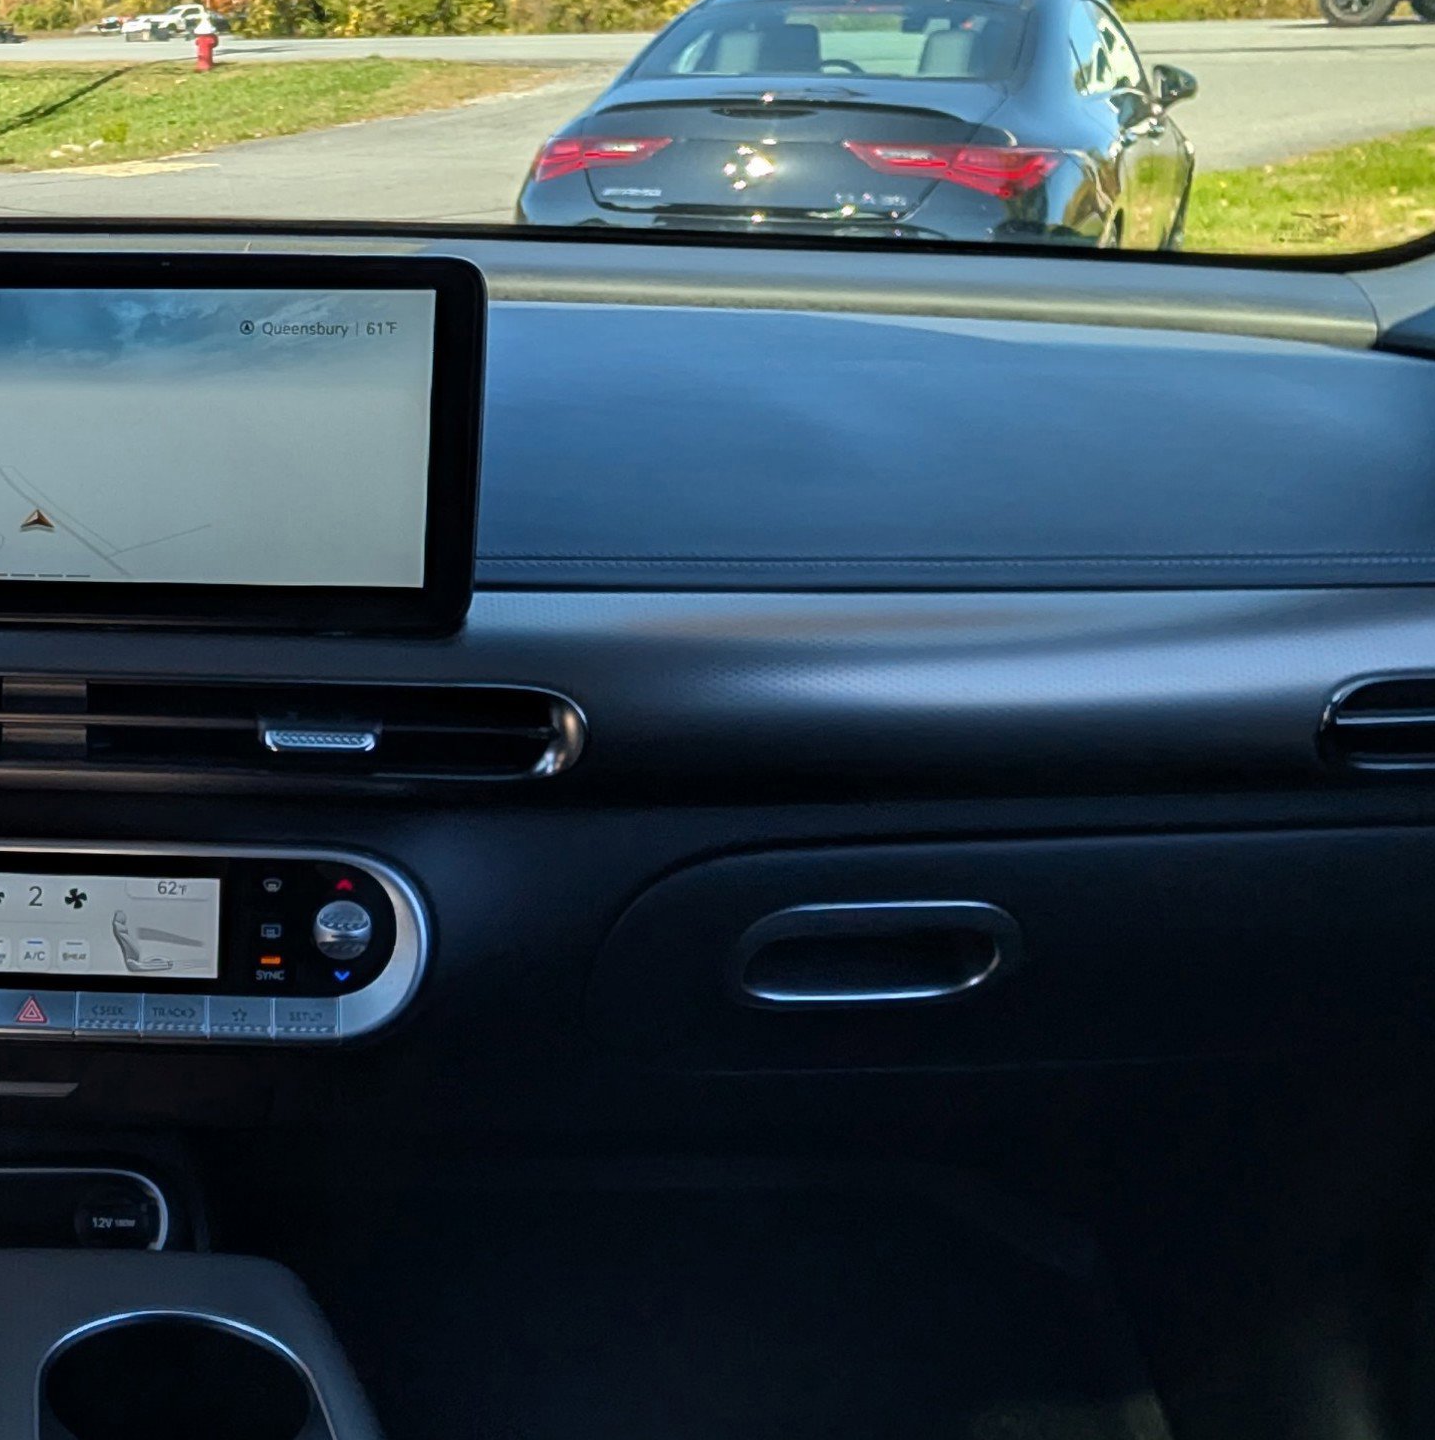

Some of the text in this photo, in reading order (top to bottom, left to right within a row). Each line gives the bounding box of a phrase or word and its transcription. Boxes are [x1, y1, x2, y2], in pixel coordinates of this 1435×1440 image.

[261, 321, 349, 338] Queensbury
[27, 885, 44, 907] 2
[23, 950, 46, 961] A/C
[255, 969, 285, 982] SYNC
[92, 1217, 113, 1229] 12V
